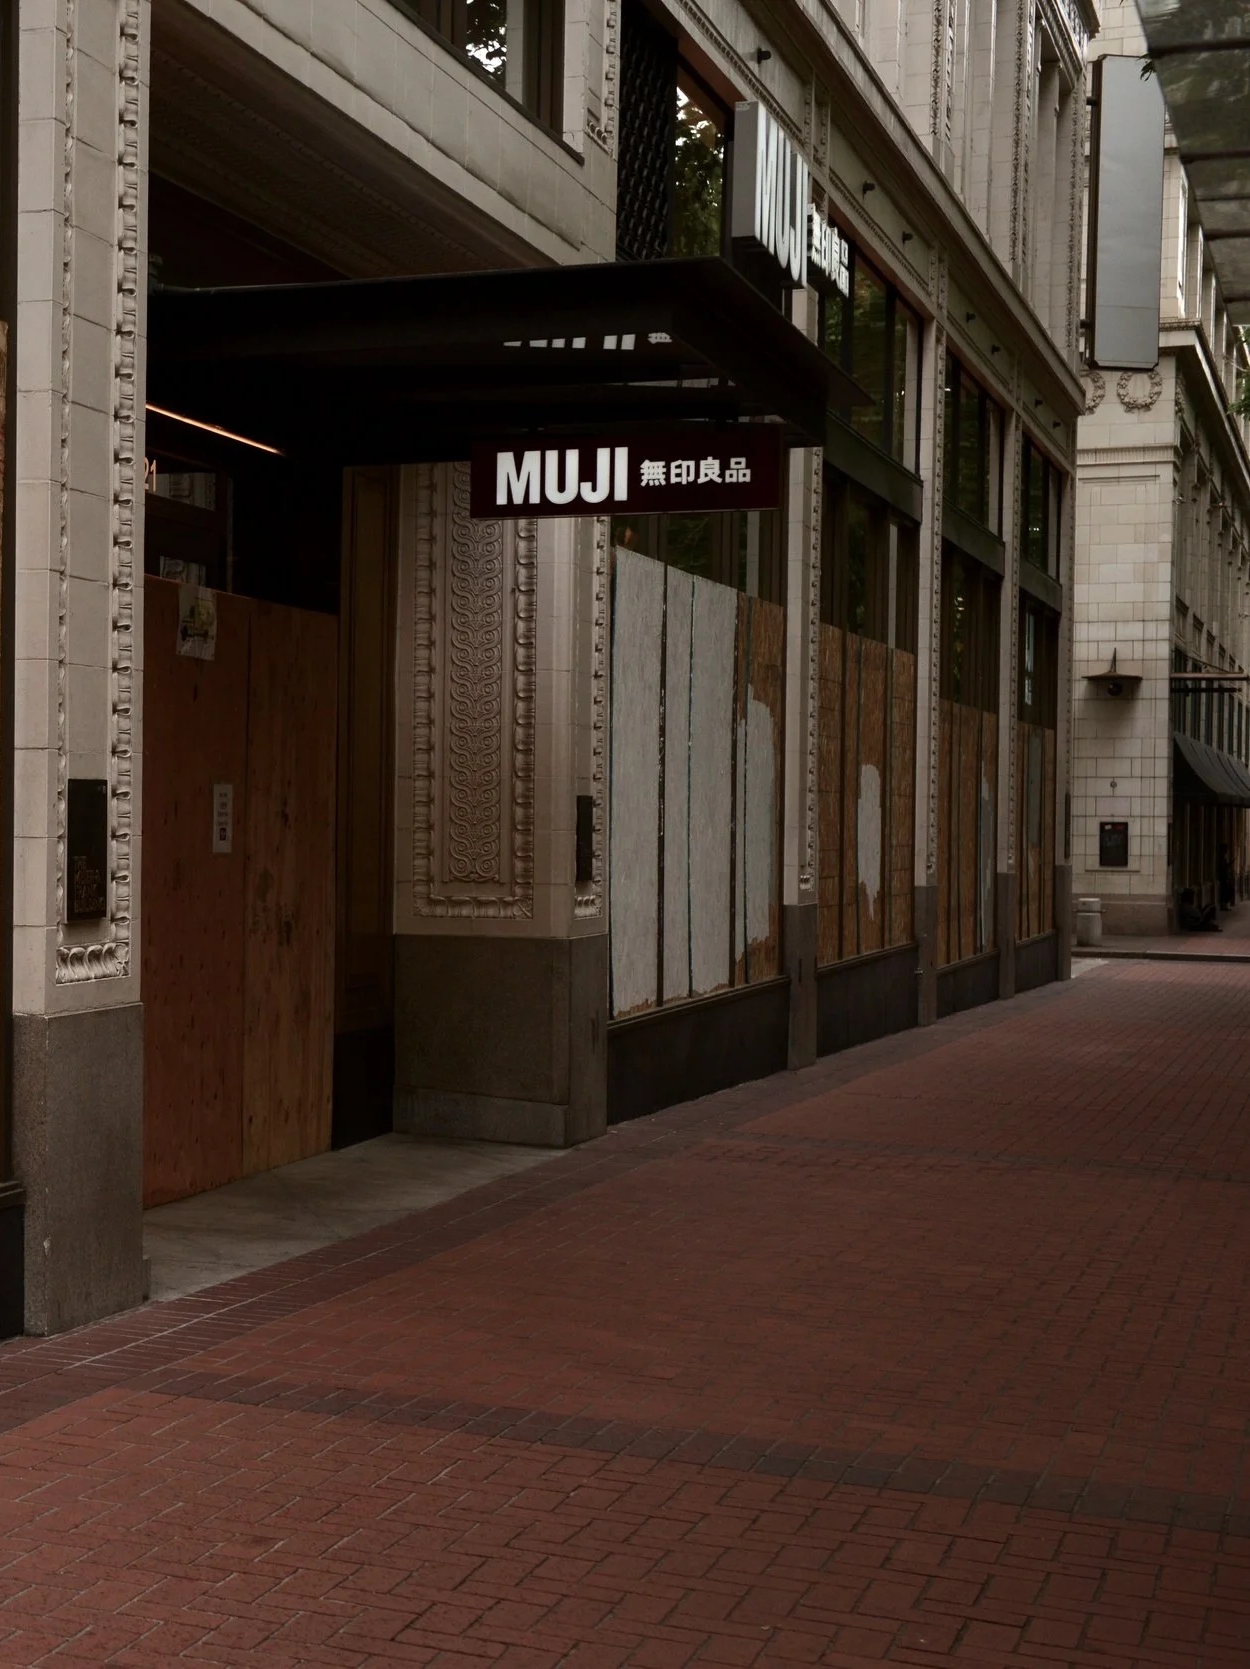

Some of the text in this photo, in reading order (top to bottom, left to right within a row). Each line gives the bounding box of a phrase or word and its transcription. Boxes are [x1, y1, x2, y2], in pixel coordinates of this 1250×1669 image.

[754, 101, 809, 287] MUJI
[496, 446, 751, 505] MUJI 無印良品
